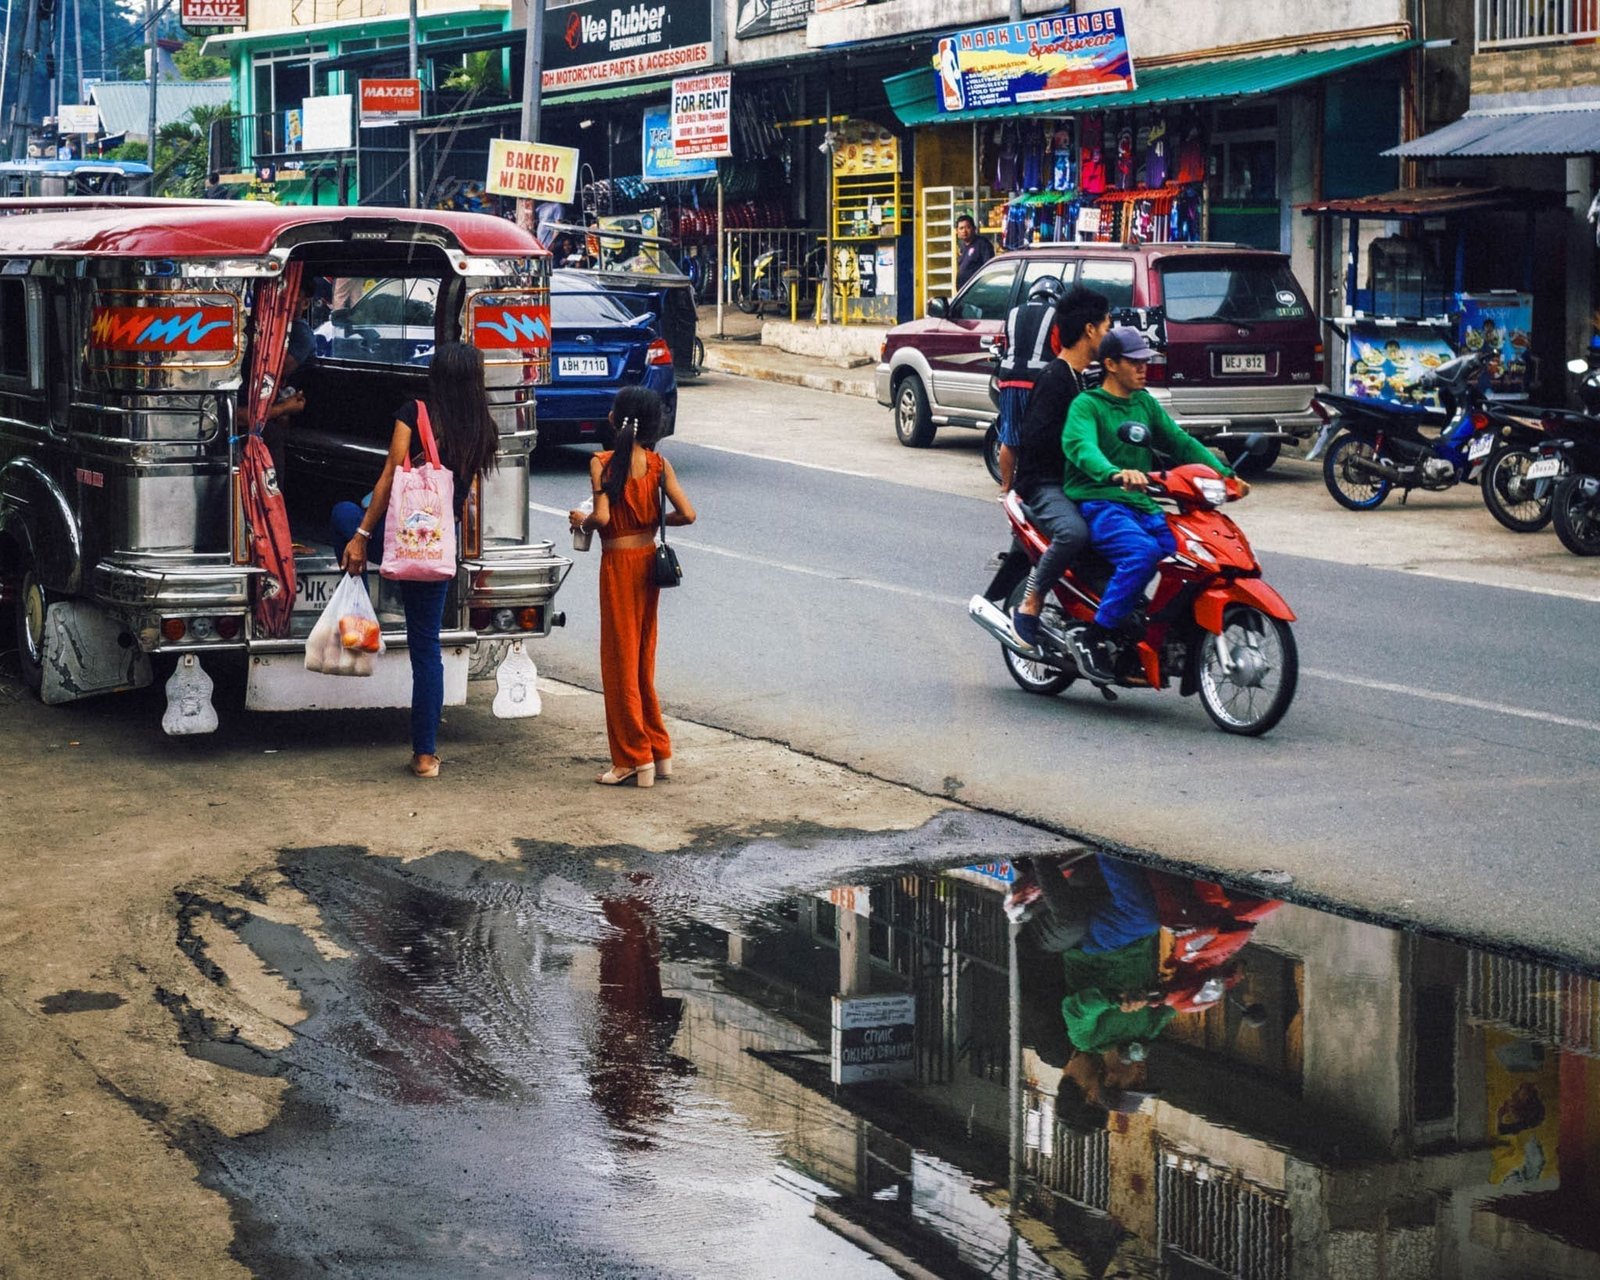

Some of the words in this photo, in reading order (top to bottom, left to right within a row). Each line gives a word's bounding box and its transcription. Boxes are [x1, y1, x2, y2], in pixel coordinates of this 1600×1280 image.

[188, 4, 240, 16] HAUZ
[581, 14, 608, 43] Vee
[609, 3, 666, 38] Rubber
[961, 27, 1009, 50] MARK
[1014, 11, 1116, 42] LOURENCE
[609, 34, 647, 52] PERFORMANCE
[647, 31, 662, 45] TIRES
[1028, 32, 1115, 60] Sportswear
[541, 71, 555, 87] DH
[556, 65, 607, 84] MOTORCYCLE
[609, 59, 635, 76] PARTS
[638, 58, 645, 72] &
[645, 46, 707, 71] ACCESSORIES
[981, 61, 1028, 71] SUBLIMATION
[364, 86, 415, 97] MAXXIS
[675, 78, 710, 94] COMMERCIAL
[711, 75, 729, 89] SPACE
[675, 95, 695, 114] FOR
[698, 90, 728, 110] RENT
[506, 151, 560, 173] BAKERY
[499, 171, 514, 189] NI
[517, 173, 564, 195] BUNSO
[562, 360, 579, 371] ABH
[582, 360, 606, 371] 7110
[1225, 357, 1242, 368] WEJ
[1246, 357, 1262, 368] 812
